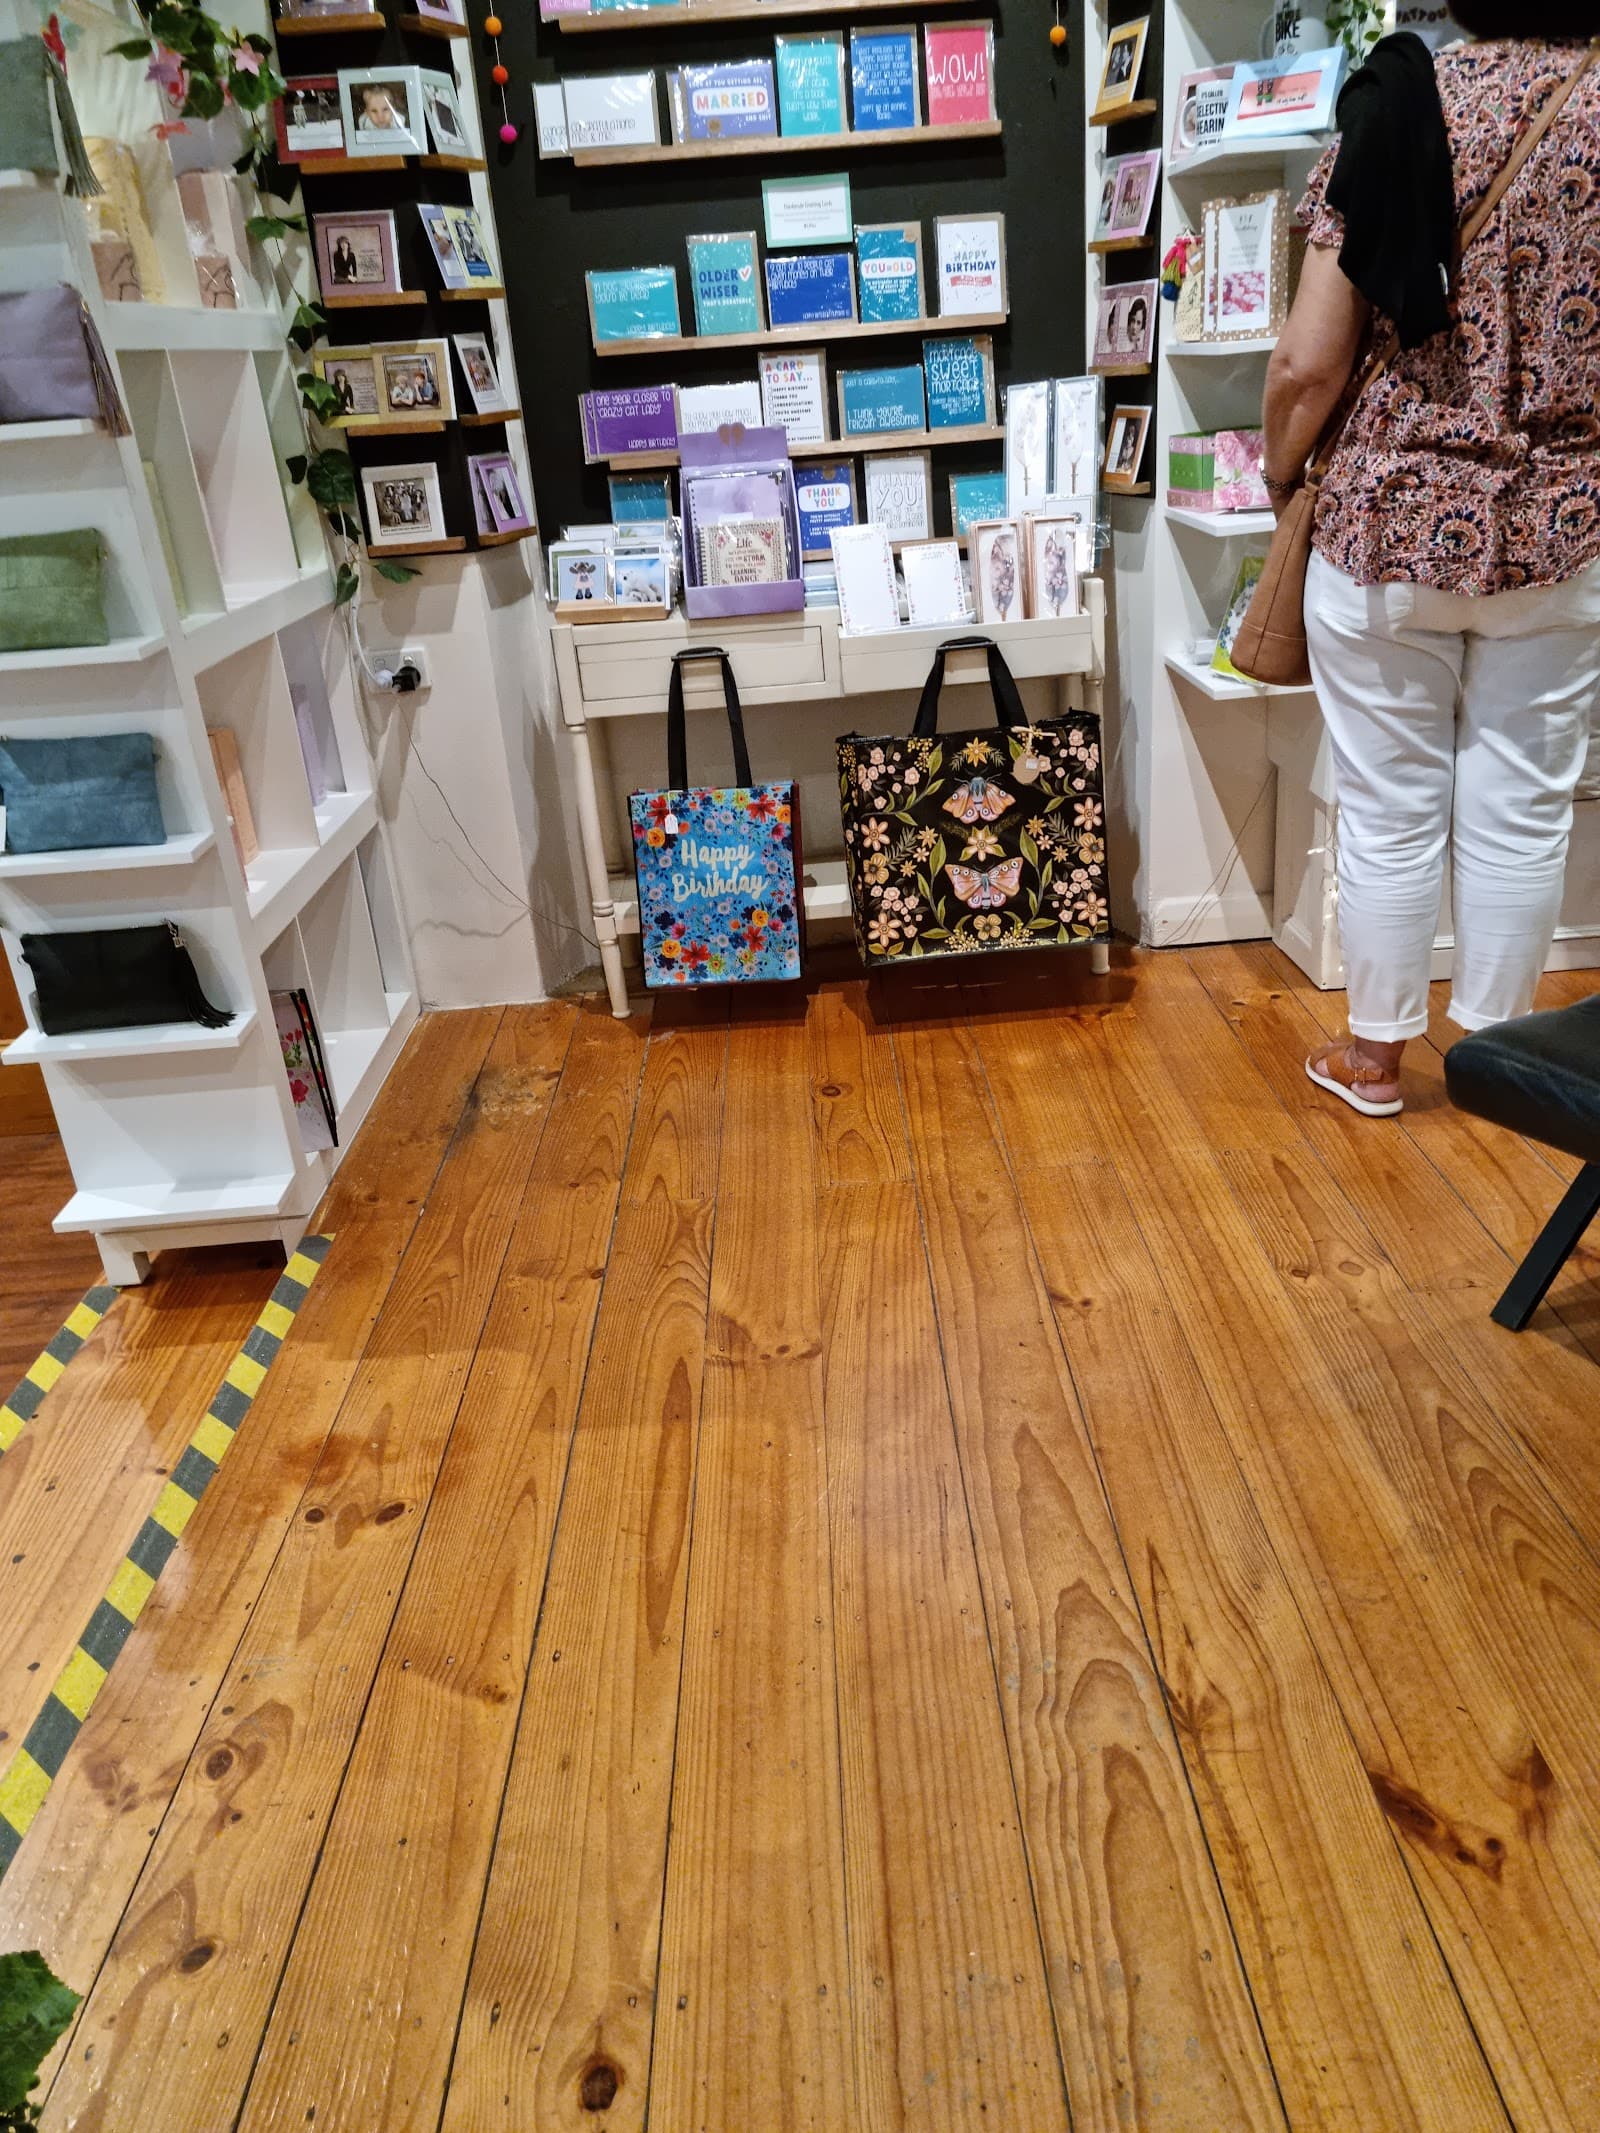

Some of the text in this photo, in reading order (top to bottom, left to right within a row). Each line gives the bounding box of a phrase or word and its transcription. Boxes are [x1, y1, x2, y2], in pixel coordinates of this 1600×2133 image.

[1276, 20, 1300, 42] BIKE
[929, 52, 985, 85] WOW!
[1197, 101, 1229, 118] SELECTIV
[1196, 118, 1225, 135] HEARIN
[954, 249, 987, 261] HAPPY
[698, 268, 739, 283] OLDER
[765, 360, 804, 372] A CARD
[766, 373, 779, 384] TO
[596, 390, 671, 407] ONE YEAR CLOSER TO
[624, 404, 639, 416] CAT
[853, 408, 874, 420] THINK
[805, 486, 842, 498] THANK
[814, 497, 835, 508] YOU
[736, 536, 753, 548] Life
[681, 838, 756, 871] Happy
[672, 866, 771, 902] Birthday
